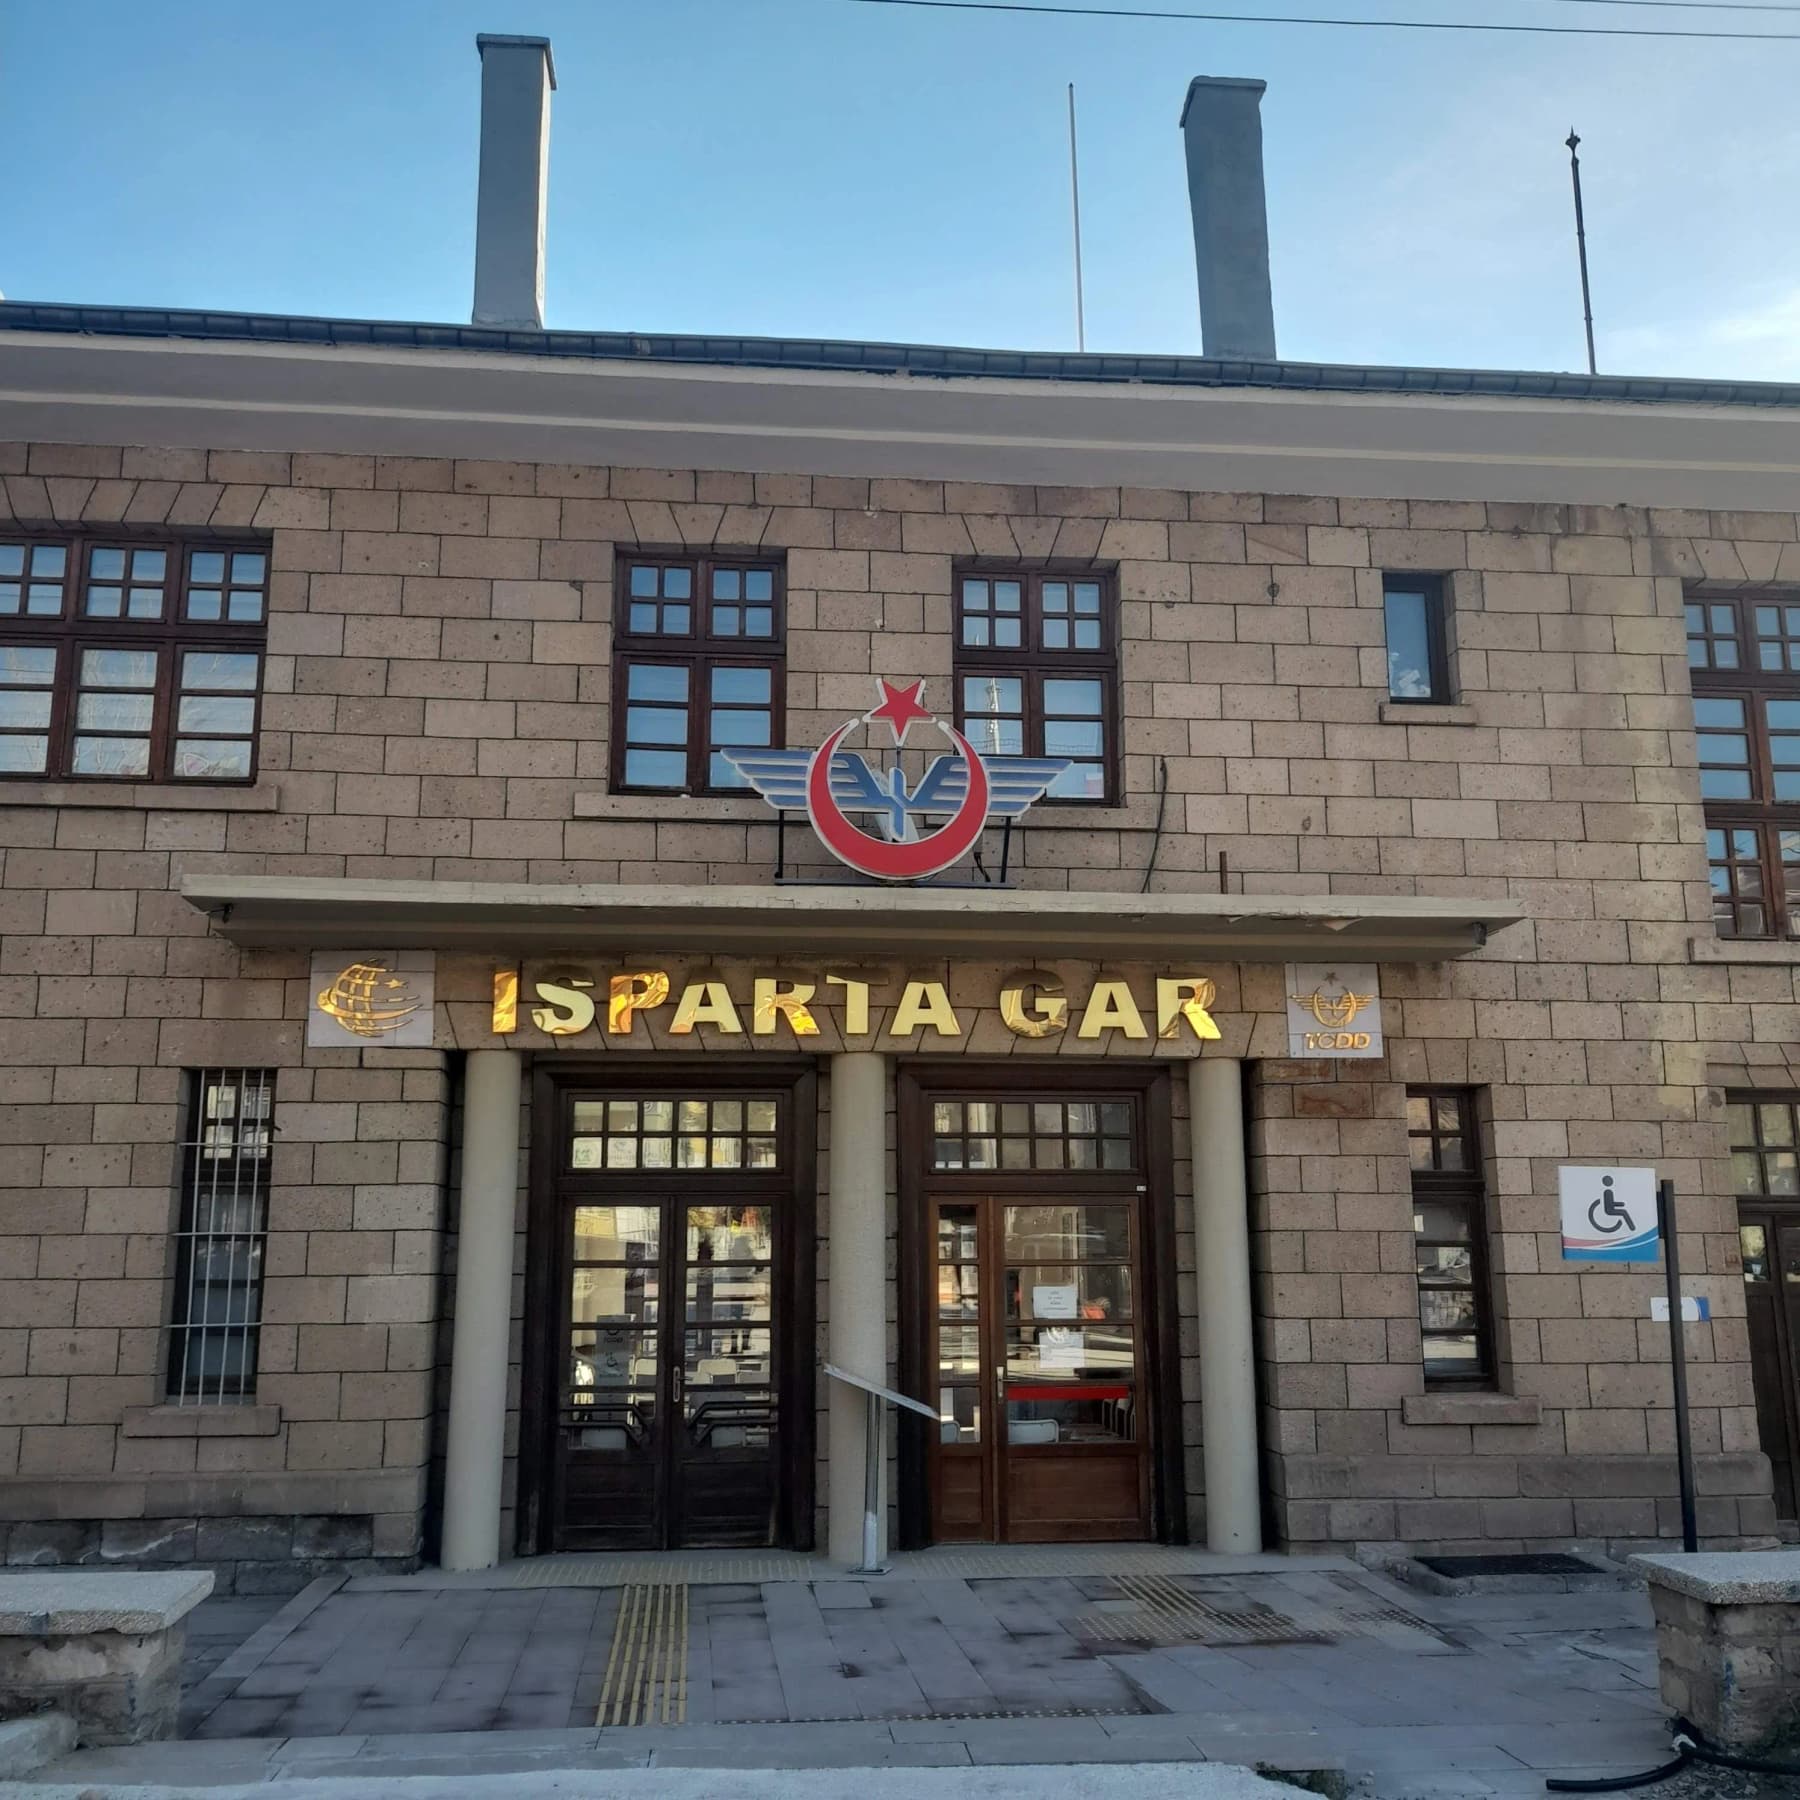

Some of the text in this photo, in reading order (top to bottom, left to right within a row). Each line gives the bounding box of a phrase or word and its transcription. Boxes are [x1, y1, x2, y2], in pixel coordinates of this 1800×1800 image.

[492, 966, 1222, 1040] ISPARTA GAR
[1305, 1032, 1371, 1050] TCDD
